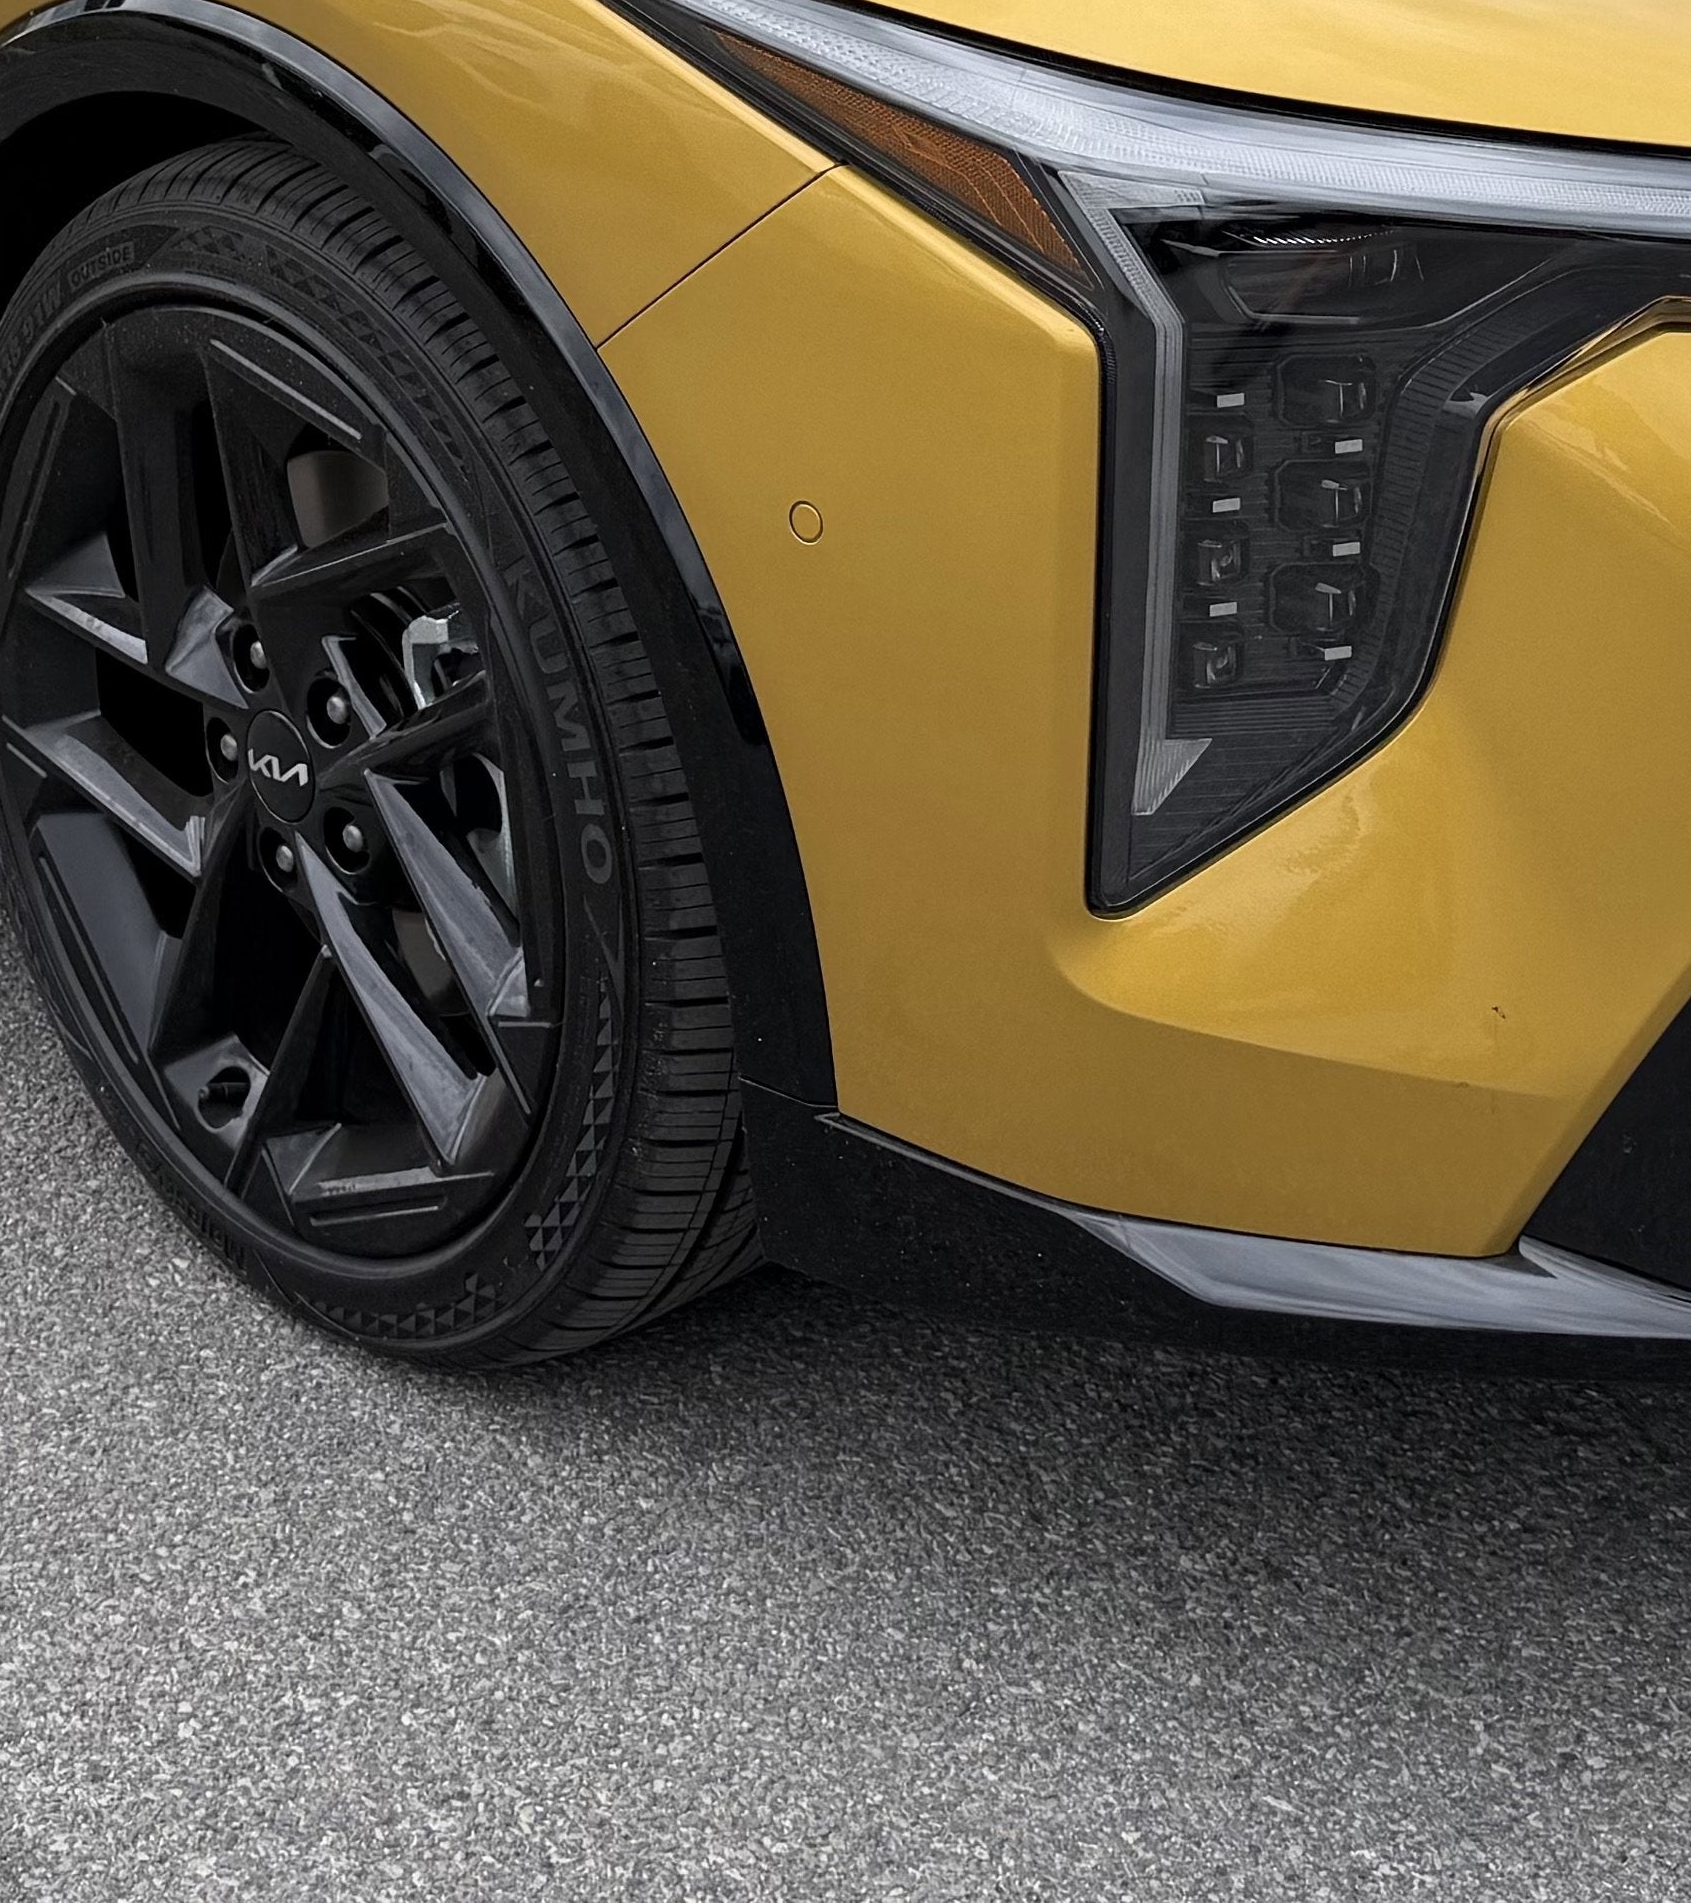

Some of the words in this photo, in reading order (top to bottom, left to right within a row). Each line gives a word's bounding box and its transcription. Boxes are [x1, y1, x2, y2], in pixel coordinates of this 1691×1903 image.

[70, 245, 134, 288] OUTSIDE
[499, 557, 613, 884] KUMHO
[247, 748, 309, 787] KIA
